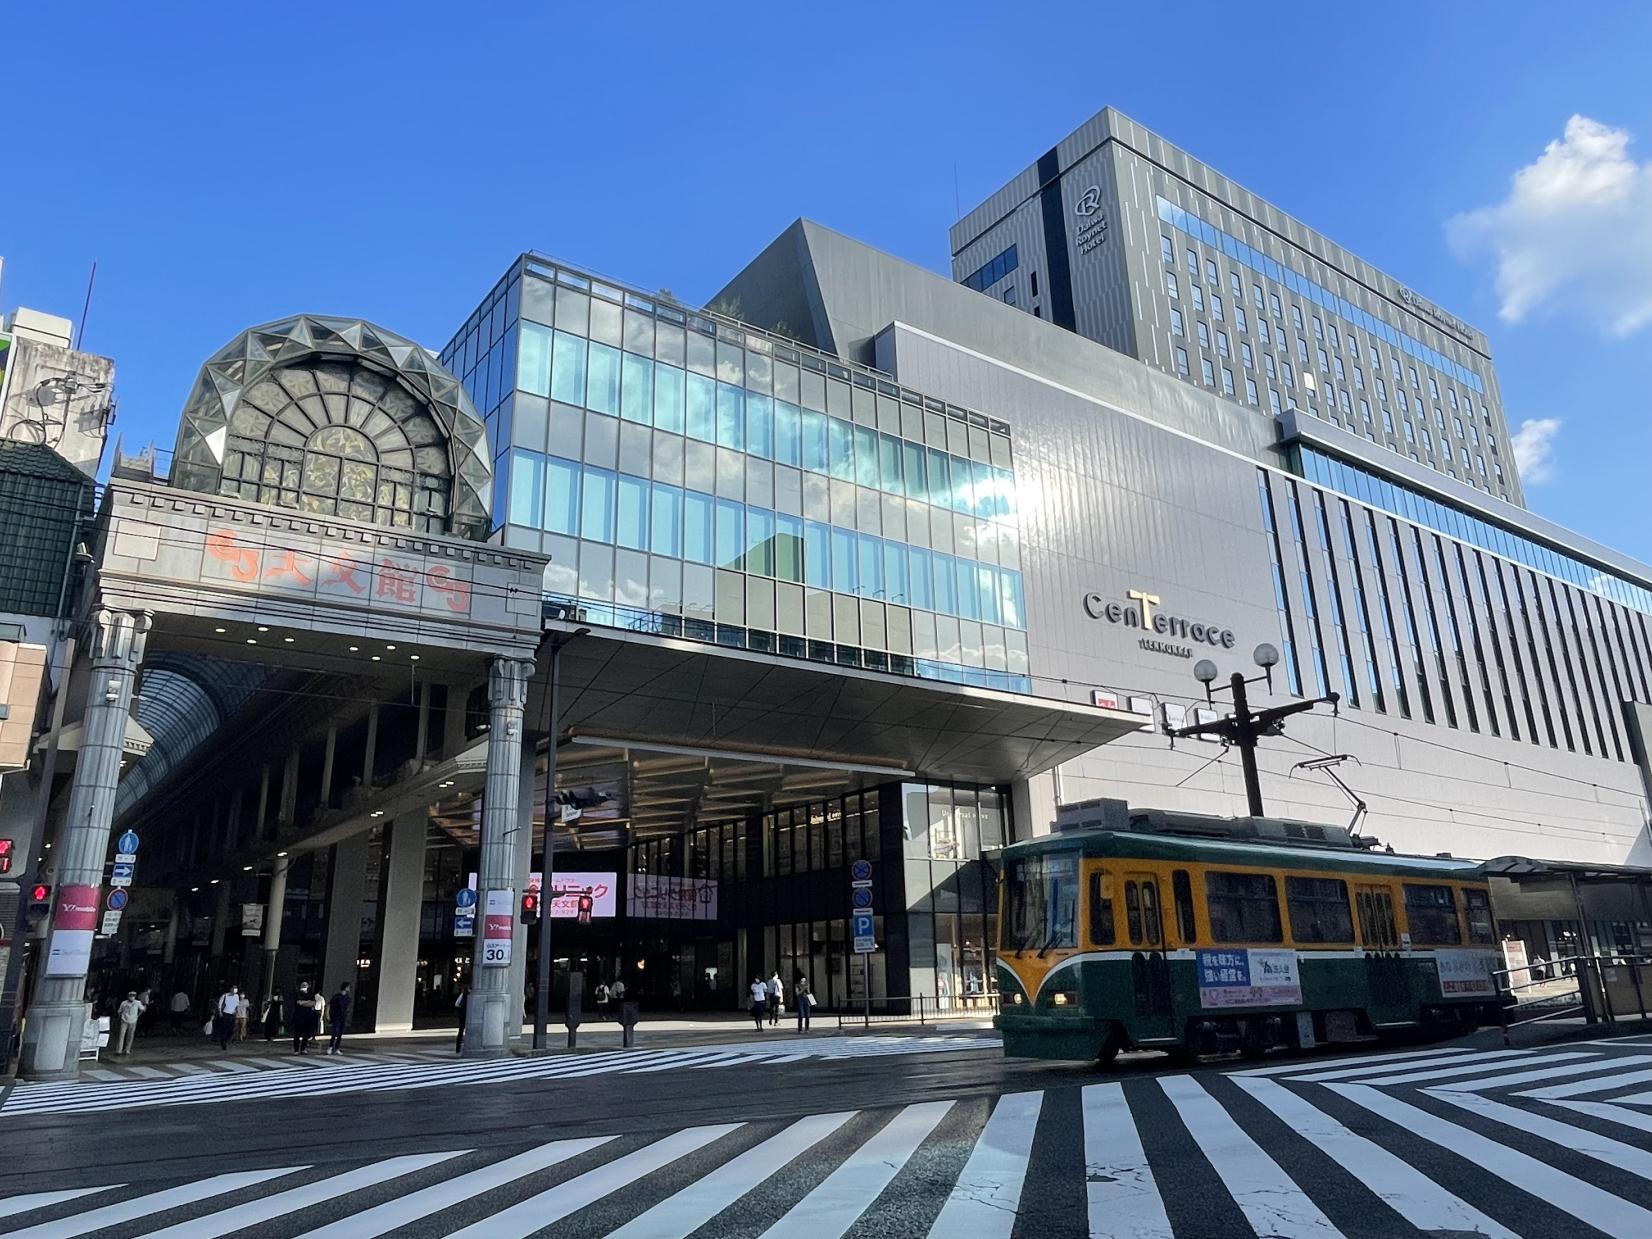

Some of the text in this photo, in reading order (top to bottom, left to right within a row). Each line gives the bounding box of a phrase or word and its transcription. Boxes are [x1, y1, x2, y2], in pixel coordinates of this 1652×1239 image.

[1076, 220, 1108, 247] Roynet
[1077, 213, 1104, 236] Daiwa
[1080, 232, 1106, 256] Hotel
[1083, 588, 1236, 650] CenTerrace
[858, 917, 870, 935] P
[486, 949, 505, 961] 30
